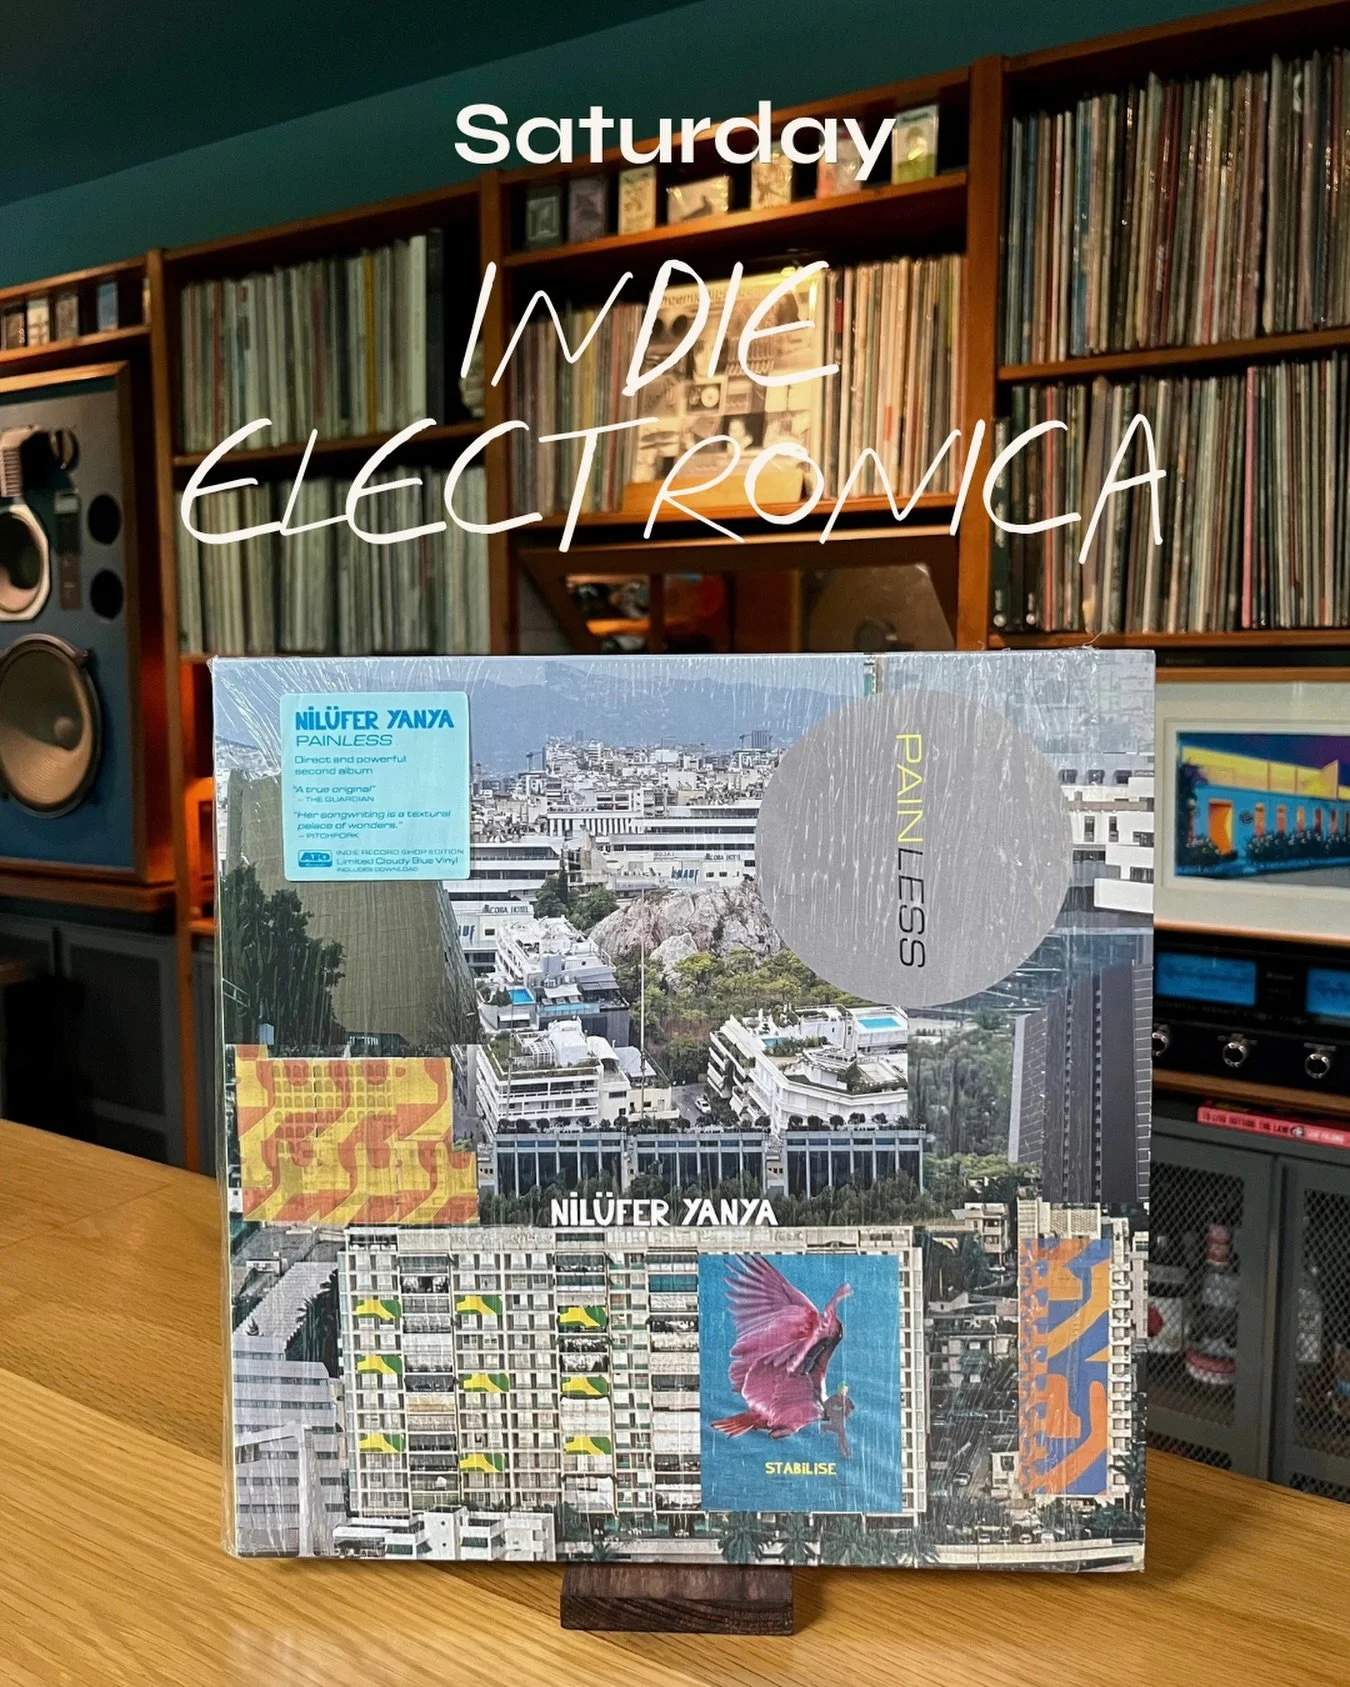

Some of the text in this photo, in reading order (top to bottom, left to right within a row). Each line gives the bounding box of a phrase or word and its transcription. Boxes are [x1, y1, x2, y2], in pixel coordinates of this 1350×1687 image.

[386, 709, 455, 730] YANYA
[296, 734, 393, 747] PAINLESS
[294, 755, 407, 765] Direct and powerful
[294, 767, 373, 775] second album
[320, 811, 385, 820] songwriting
[297, 822, 334, 831] palace
[896, 734, 926, 968] PAINLESS
[375, 857, 410, 867] Cloudy
[411, 857, 434, 865] Blue
[436, 856, 458, 866] Vinyl
[681, 1198, 779, 1226] YANYA
